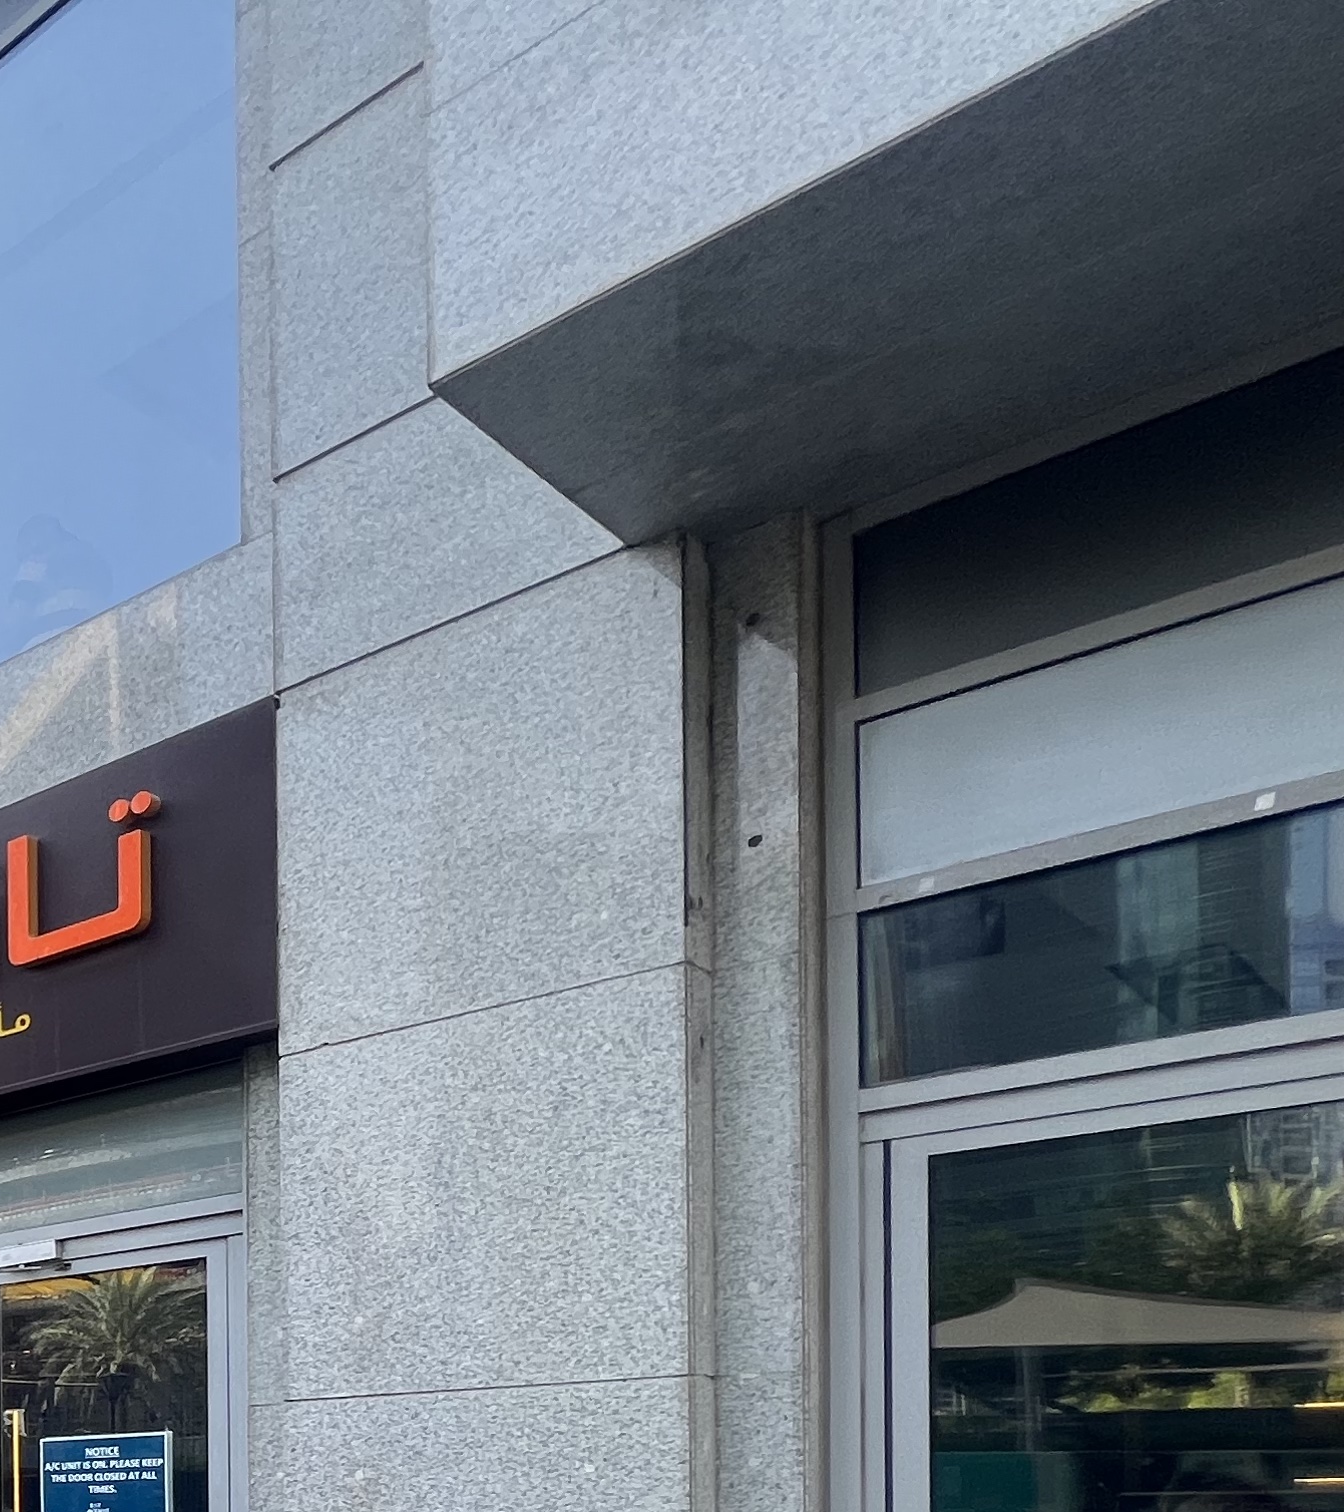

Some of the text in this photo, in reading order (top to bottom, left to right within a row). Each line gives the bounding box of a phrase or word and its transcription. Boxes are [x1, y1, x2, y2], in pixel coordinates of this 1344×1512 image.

[85, 1446, 120, 1458] NOTICE
[44, 1462, 60, 1472] A/C
[83, 1461, 91, 1469] IS
[110, 1459, 140, 1468] PLEASE
[142, 1458, 163, 1467] KEEP
[51, 1471, 157, 1482] THE DOOR CLOSED AT ALL
[88, 1485, 117, 1494] TIMES.
